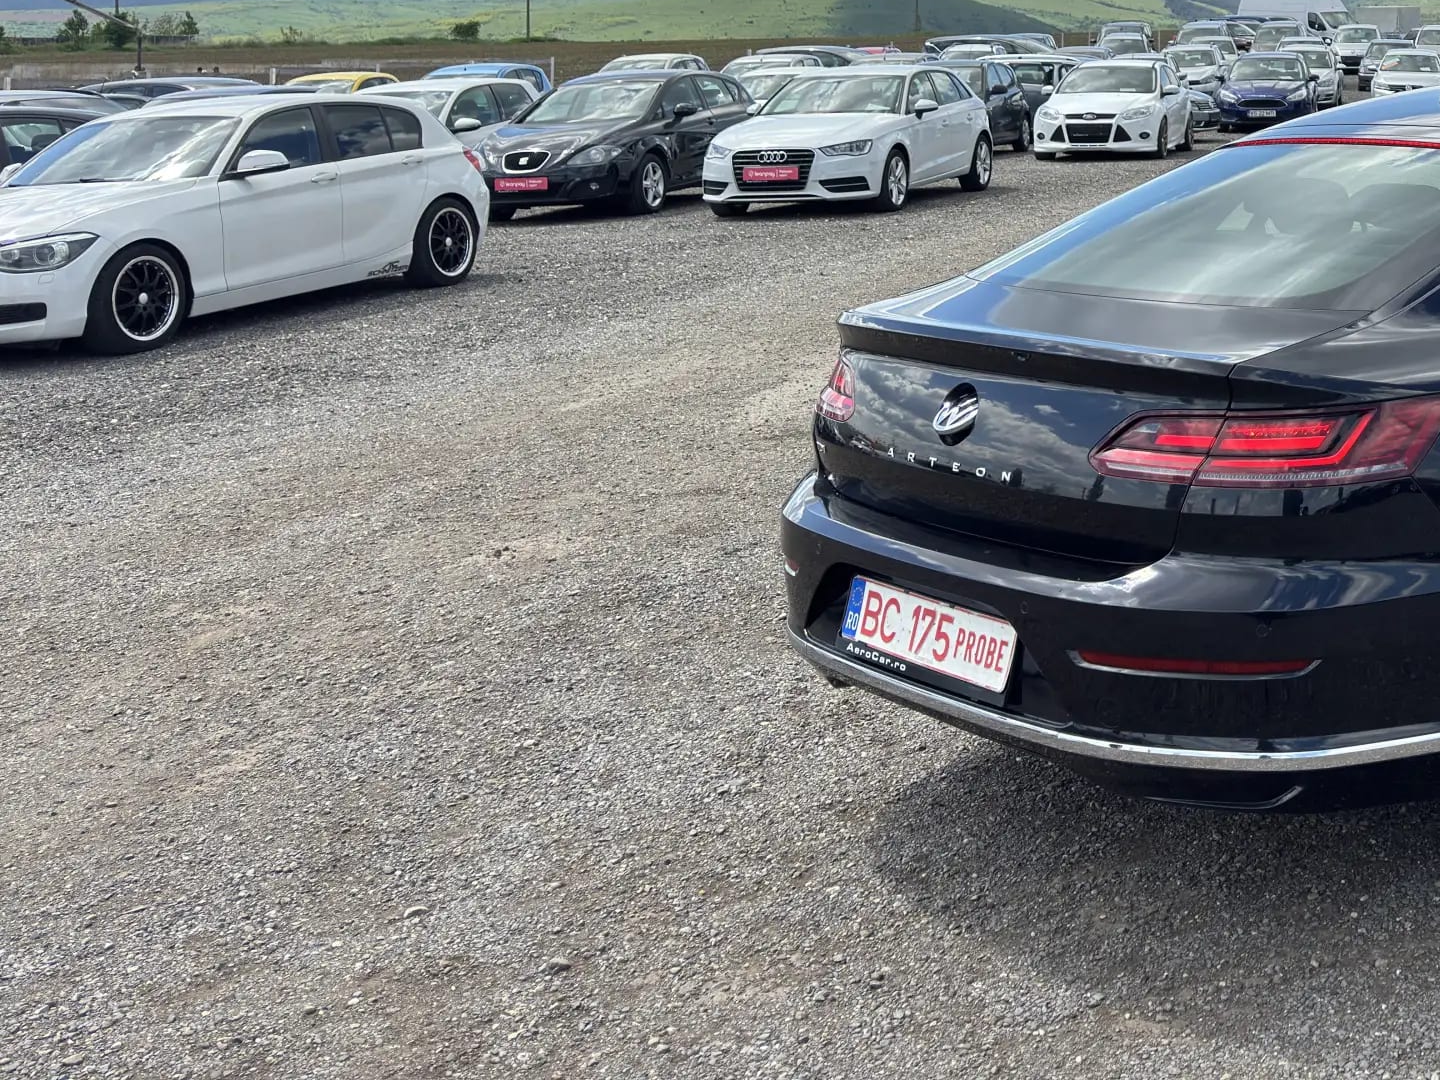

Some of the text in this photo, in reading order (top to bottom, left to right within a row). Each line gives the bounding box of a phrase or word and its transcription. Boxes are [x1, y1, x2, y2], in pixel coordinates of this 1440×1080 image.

[887, 447, 1011, 482] ARTEON
[845, 611, 859, 631] RO
[860, 590, 1009, 673] BC 175 PROBE
[846, 643, 906, 671] AeroCar.ro
